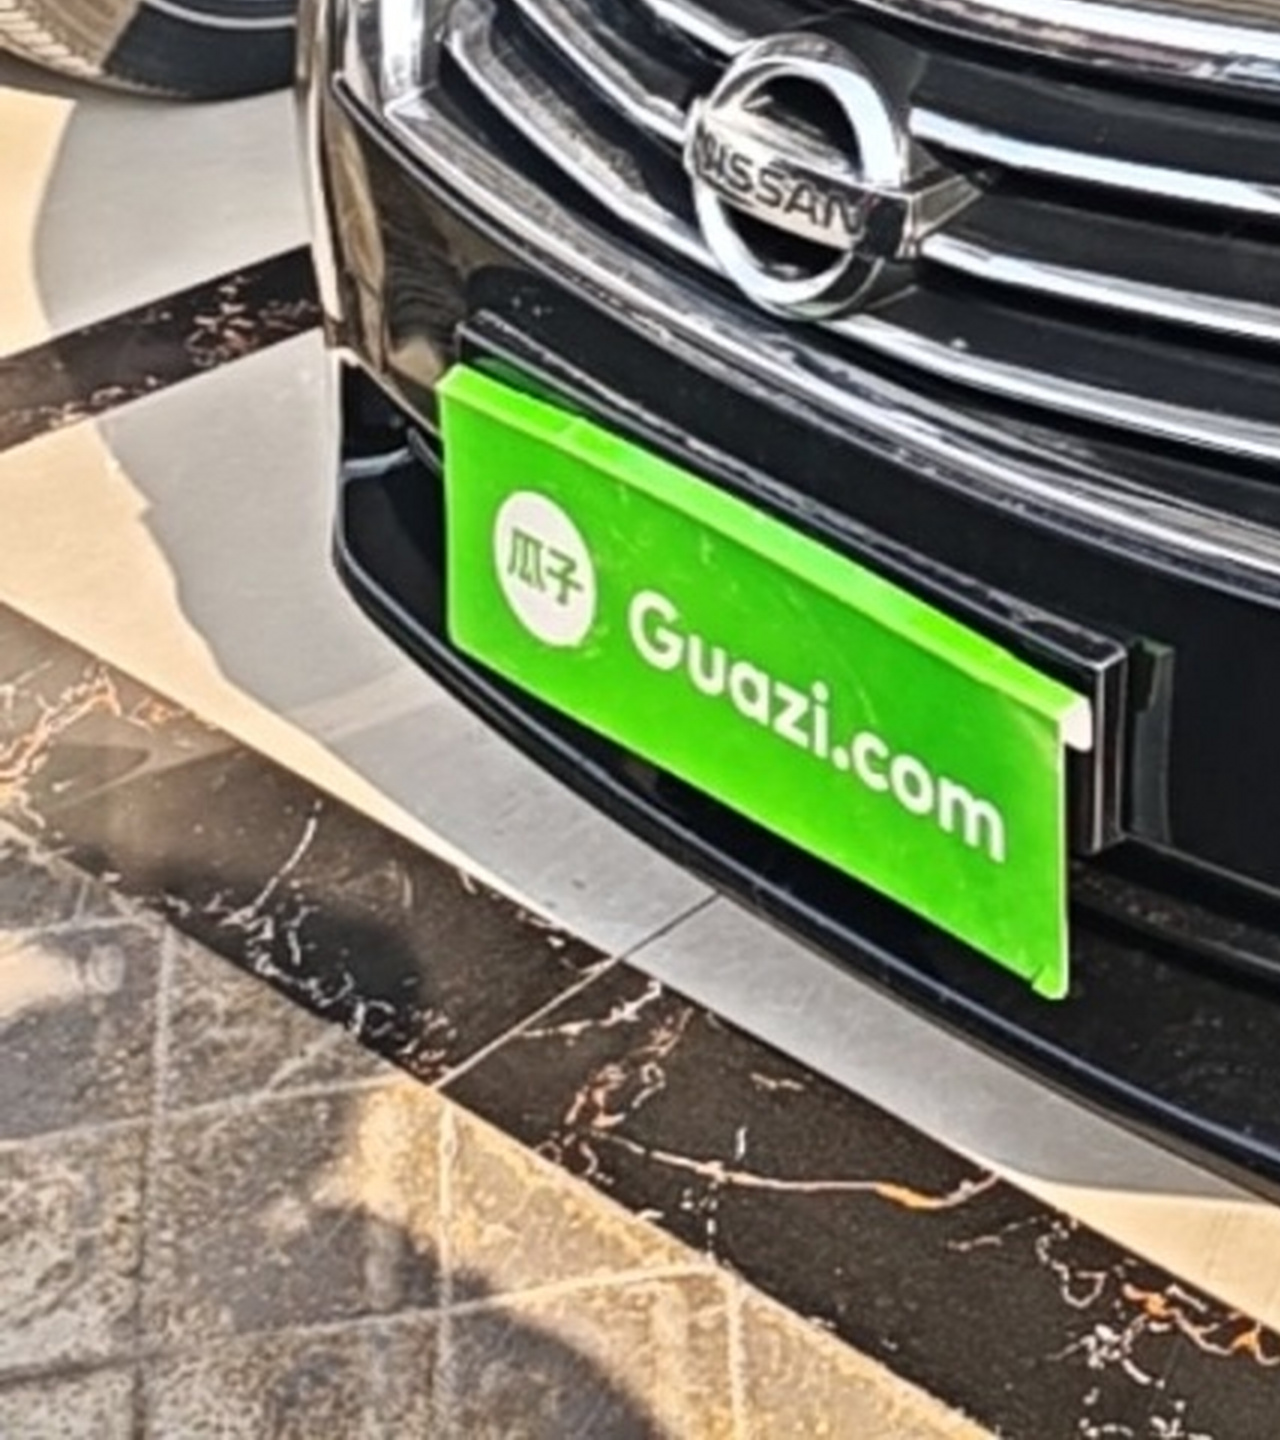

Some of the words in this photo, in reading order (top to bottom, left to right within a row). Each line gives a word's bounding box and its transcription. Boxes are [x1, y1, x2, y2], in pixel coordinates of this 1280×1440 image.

[701, 128, 865, 235] NISSAN
[508, 527, 584, 606] 瓜子
[628, 590, 1006, 863] Guazi.com
